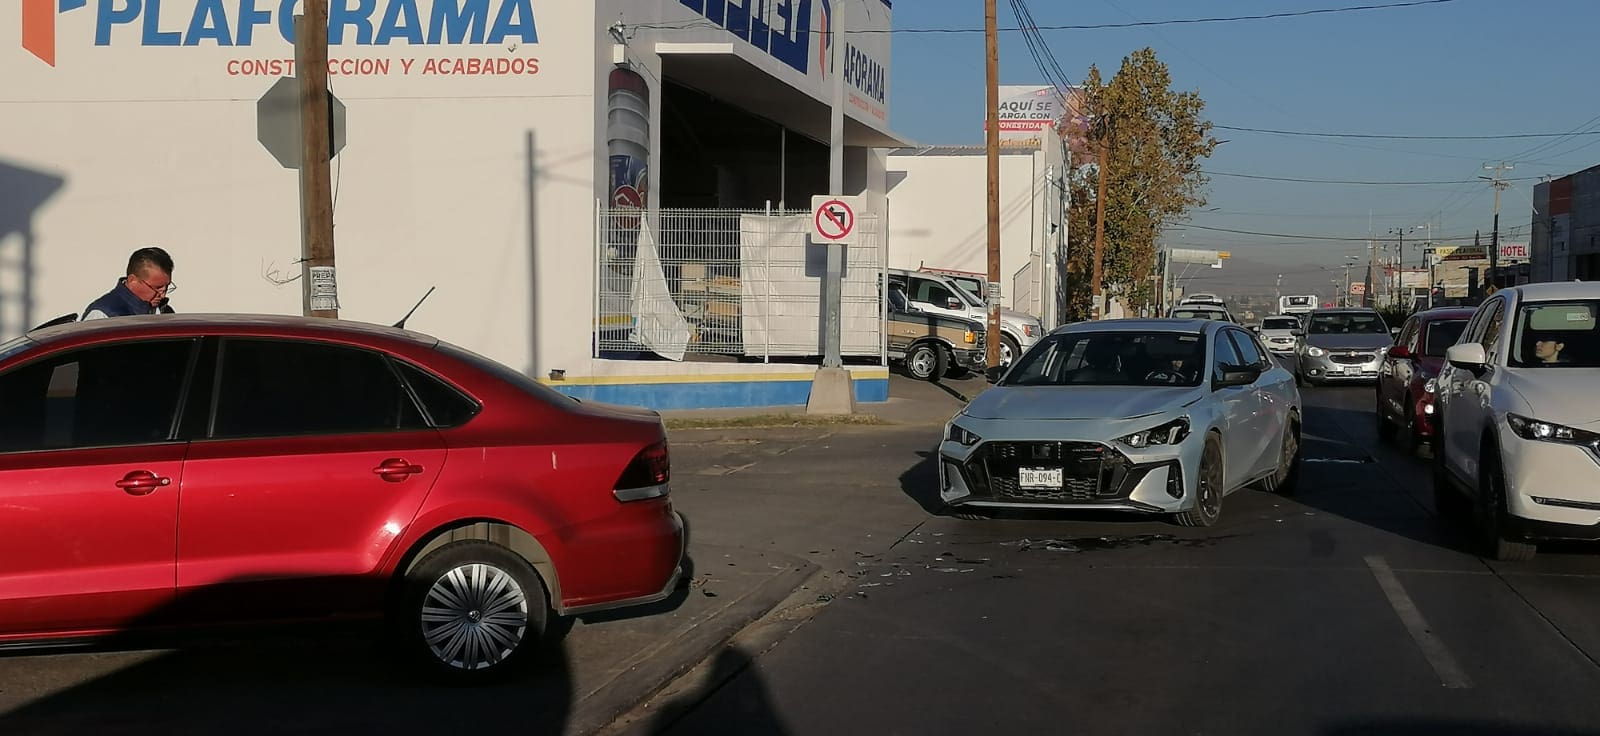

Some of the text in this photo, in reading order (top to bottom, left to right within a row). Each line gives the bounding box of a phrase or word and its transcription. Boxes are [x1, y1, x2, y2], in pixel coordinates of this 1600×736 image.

[227, 57, 540, 76] CONSTCCION Y ACABADOS
[999, 100, 1052, 112] AQUÍ SE
[1500, 246, 1527, 256] HOTEL
[1020, 472, 1062, 483] FNR-094-C
